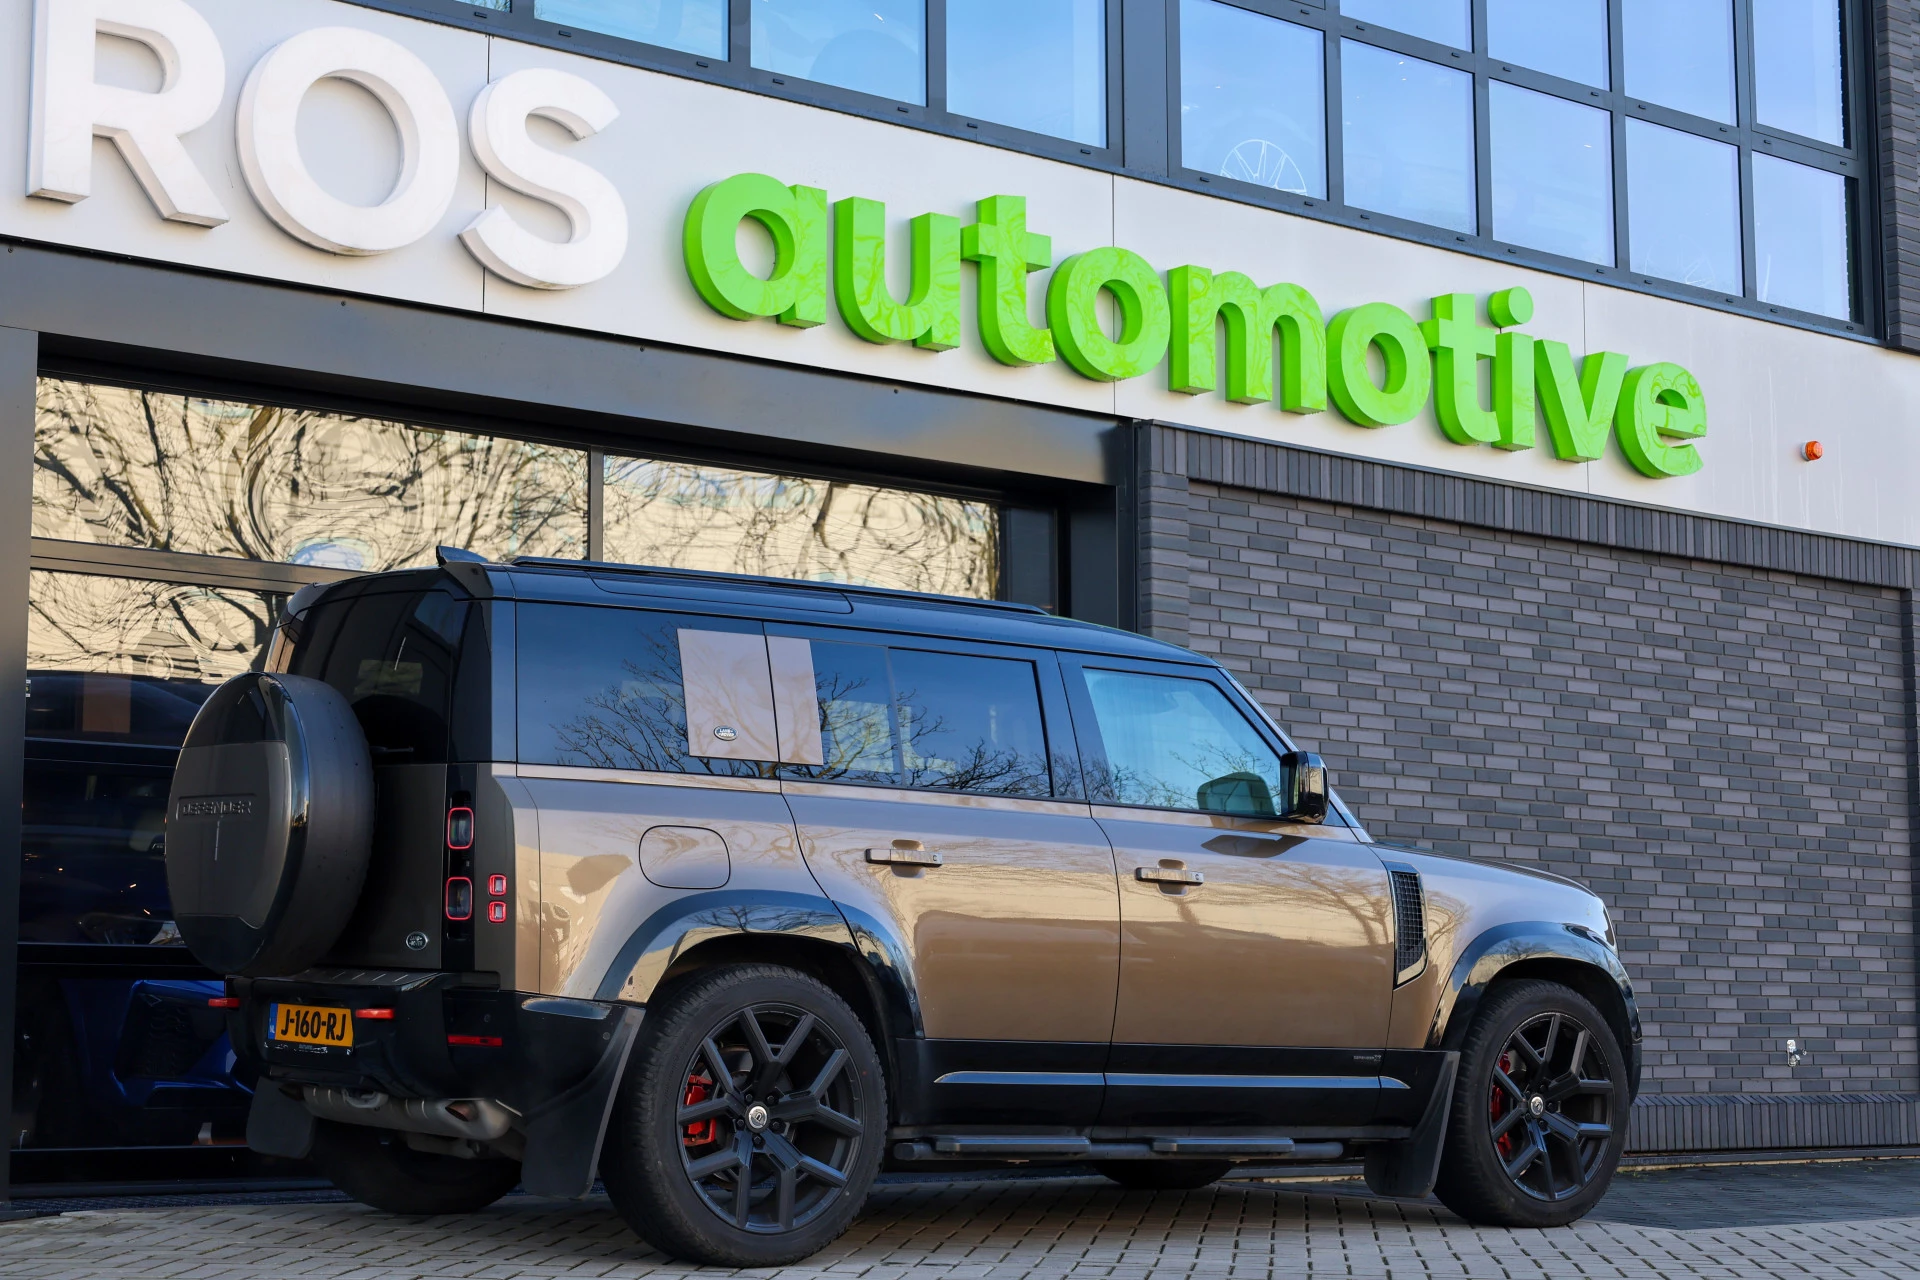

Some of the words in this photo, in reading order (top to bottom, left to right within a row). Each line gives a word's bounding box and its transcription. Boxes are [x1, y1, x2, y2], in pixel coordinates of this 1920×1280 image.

[27, 0, 629, 290] ROS
[683, 172, 1707, 478] automotive
[281, 1009, 347, 1041] J-160-RJ
